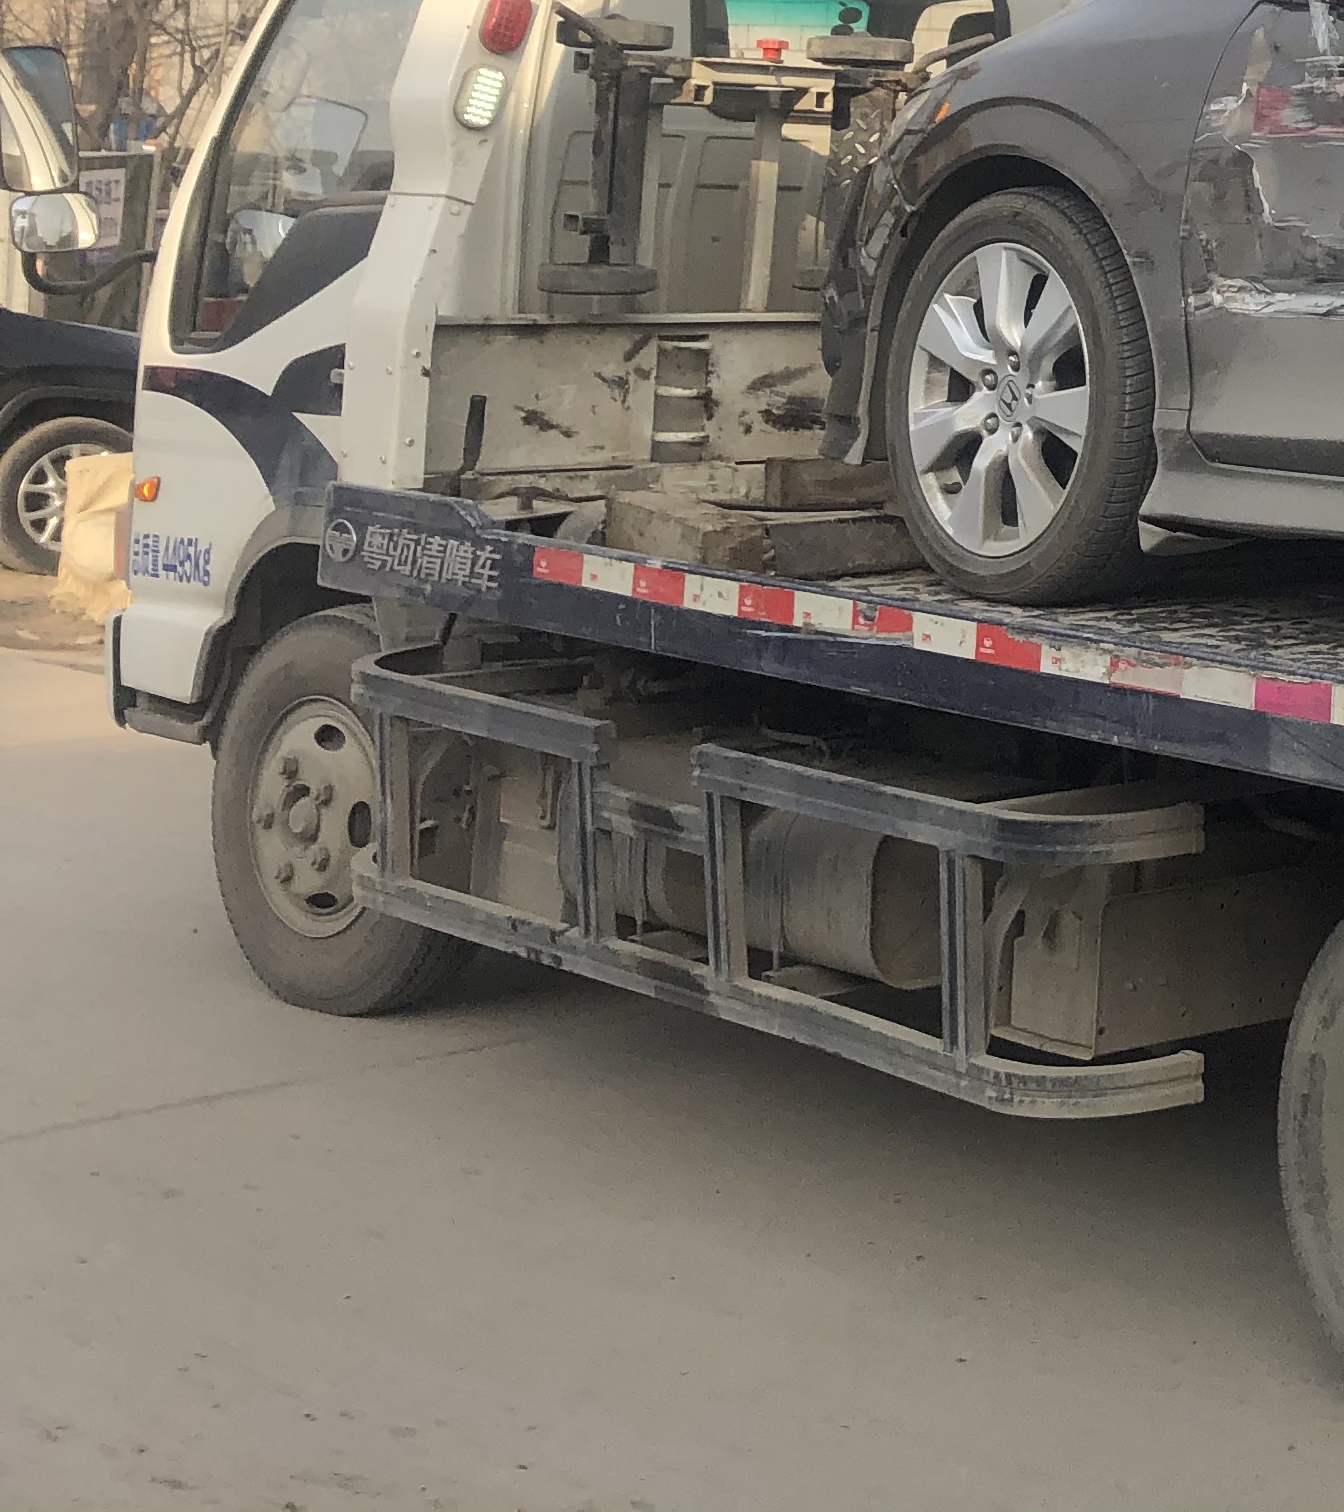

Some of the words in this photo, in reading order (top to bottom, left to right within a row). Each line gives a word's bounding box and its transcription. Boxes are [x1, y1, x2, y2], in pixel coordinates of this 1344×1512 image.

[361, 524, 502, 592] 粤海清障车
